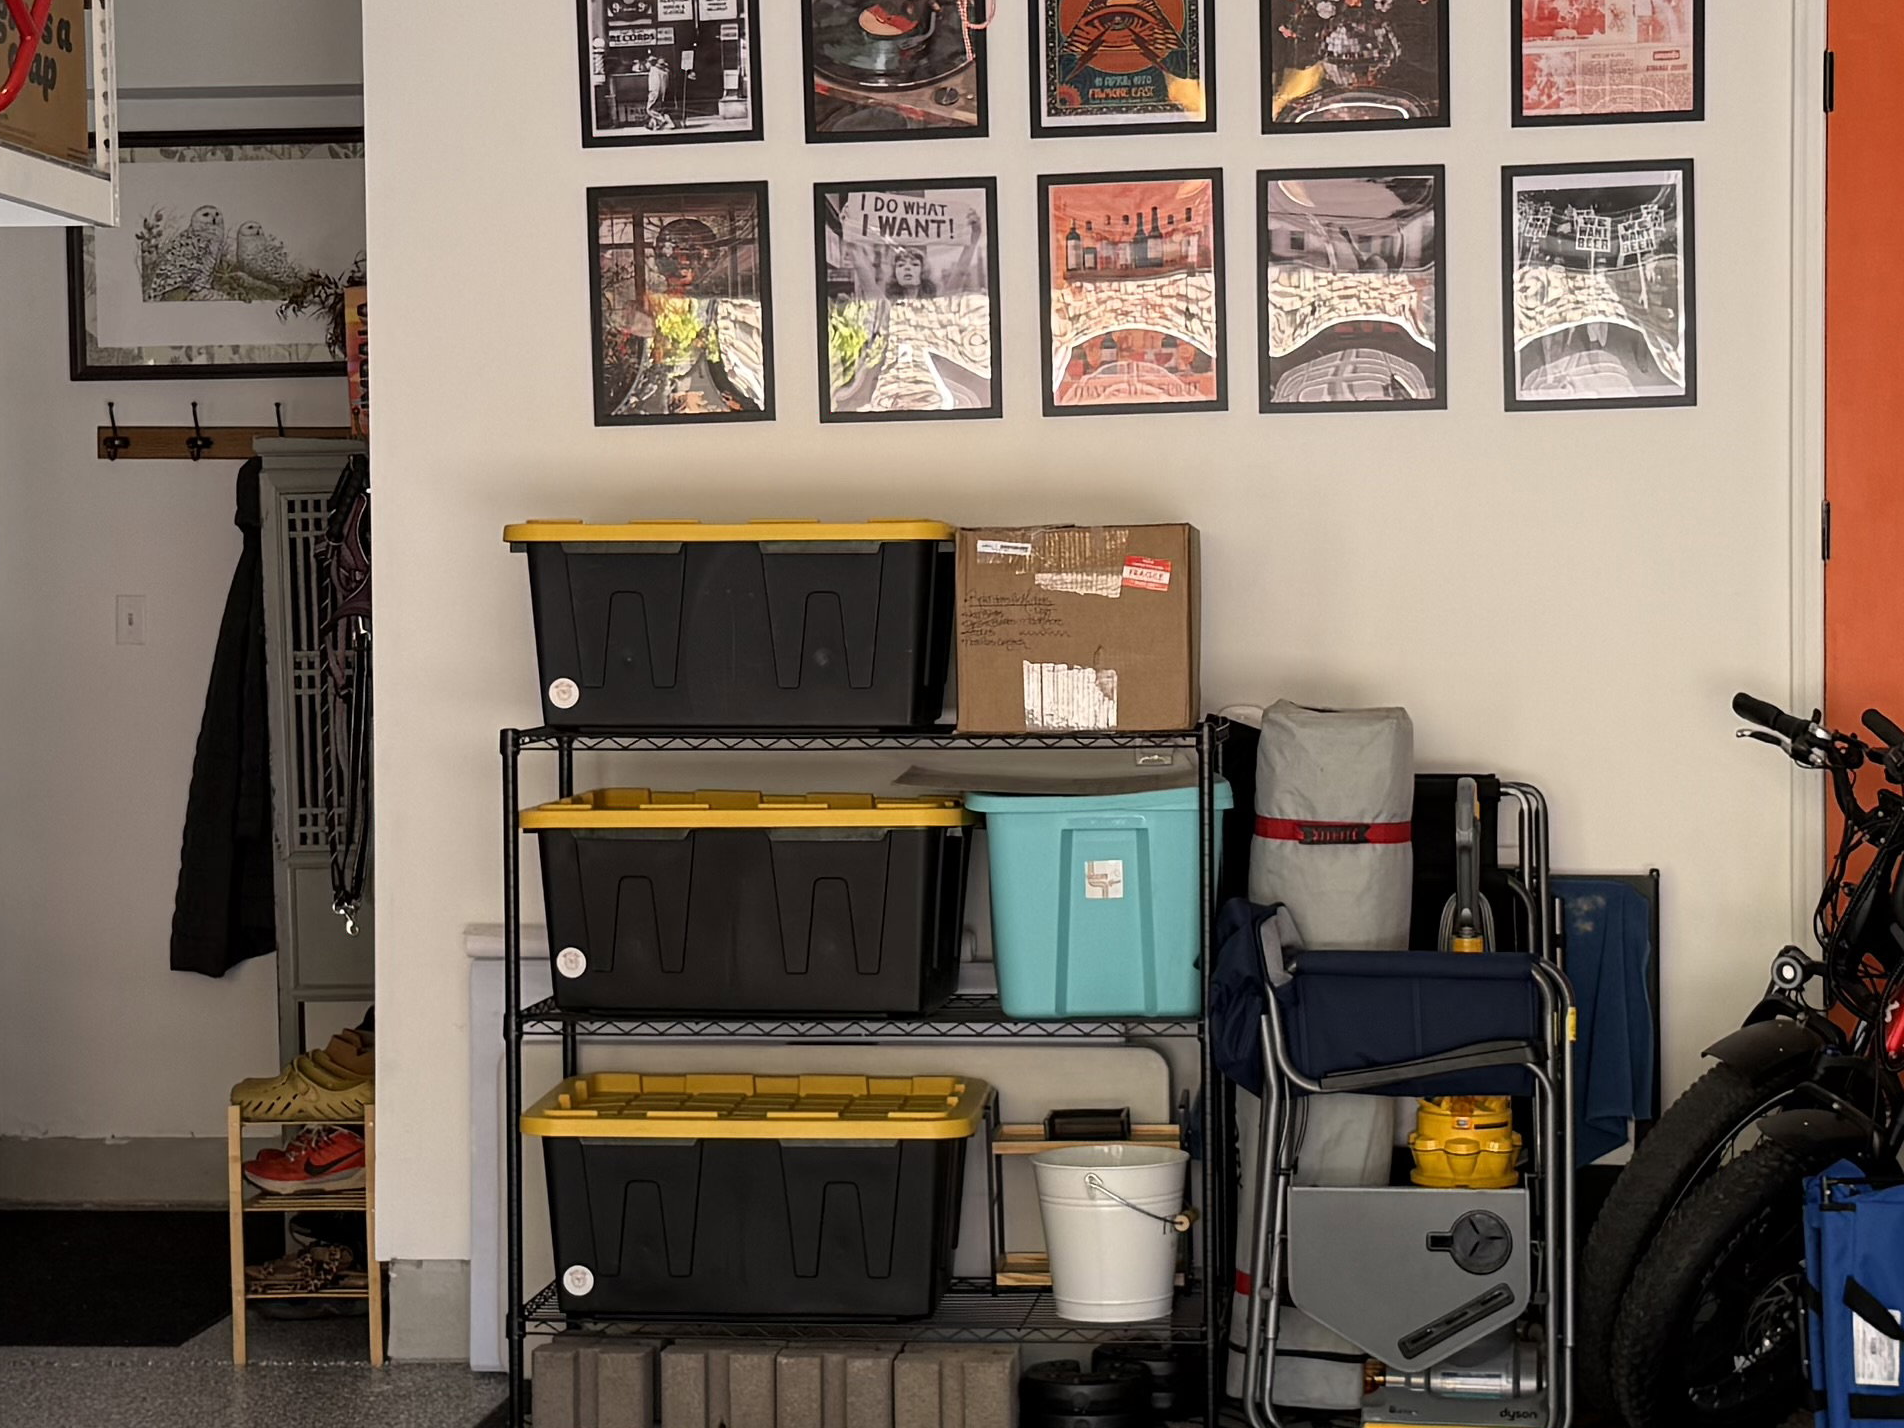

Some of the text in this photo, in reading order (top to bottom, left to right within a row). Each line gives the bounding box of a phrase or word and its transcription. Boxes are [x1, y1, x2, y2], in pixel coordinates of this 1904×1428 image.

[860, 193, 948, 217] I DO WHAT
[862, 217, 956, 240] I WANT!
[1579, 228, 1608, 238] WANT
[1577, 238, 1609, 250] BEER
[1622, 240, 1655, 253] BEER
[1499, 1407, 1538, 1421] dyson
